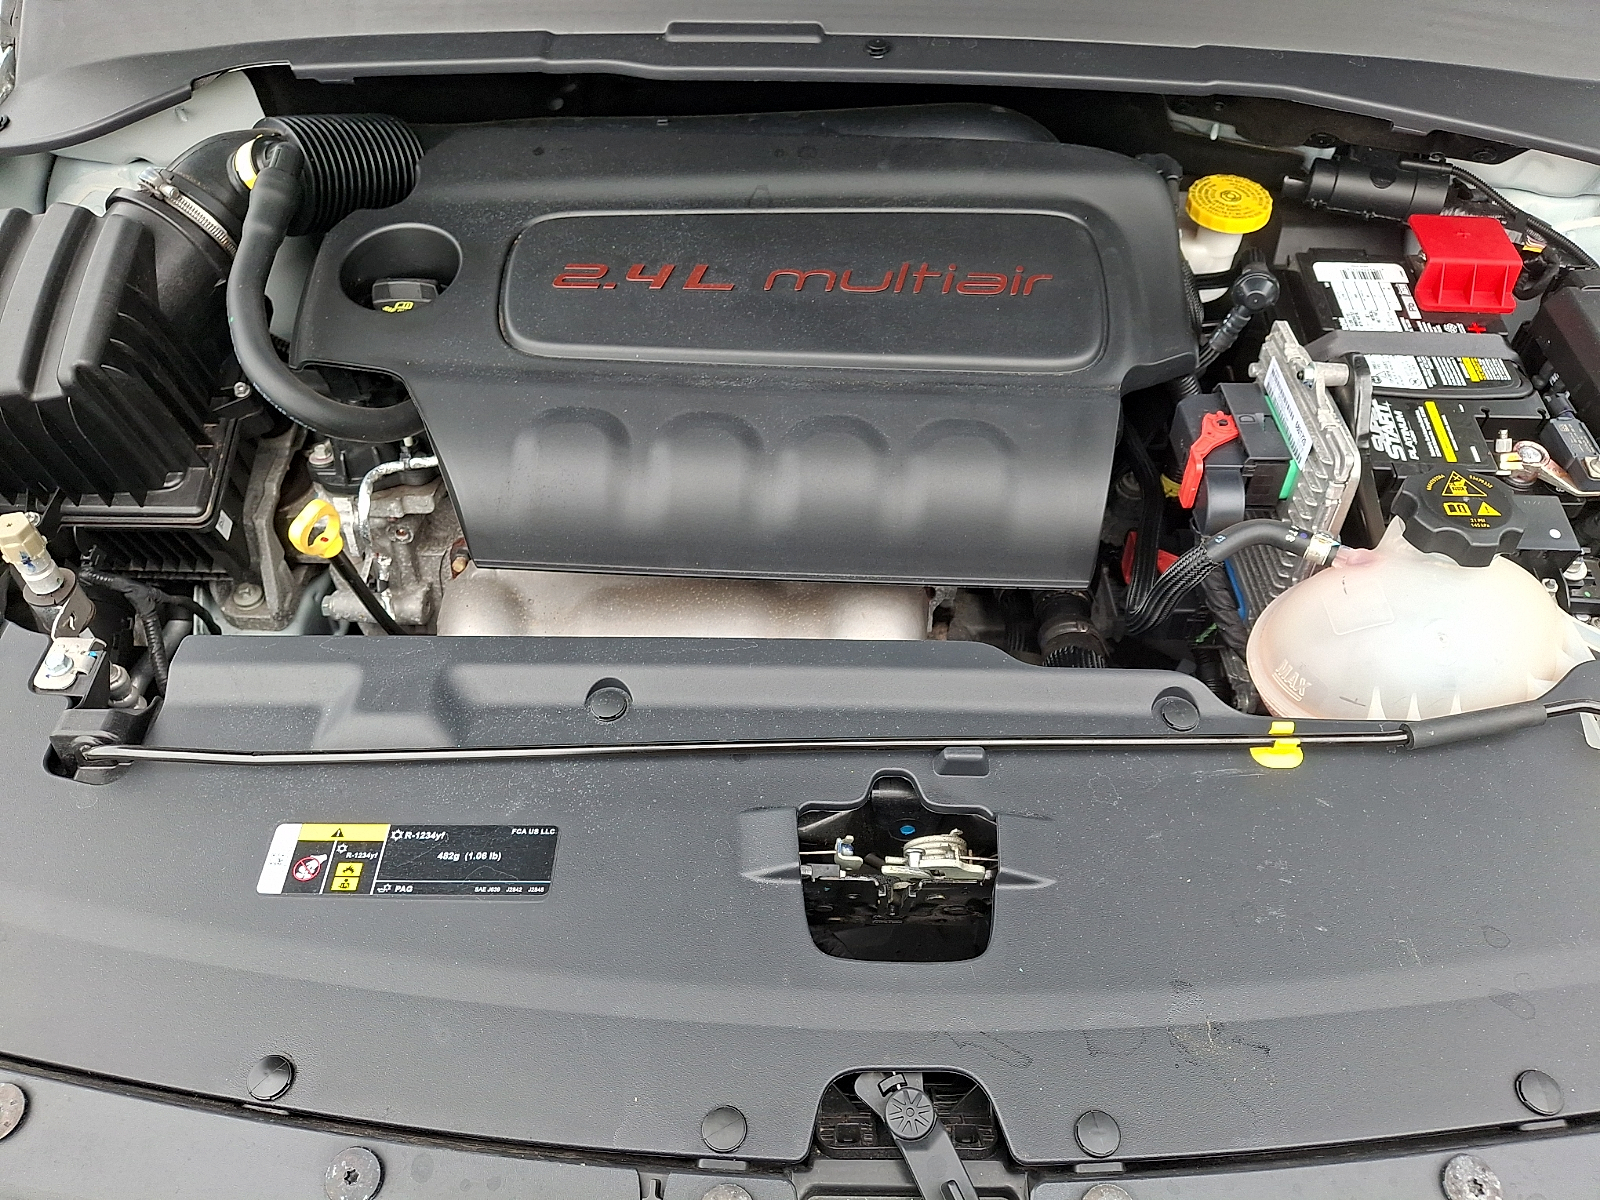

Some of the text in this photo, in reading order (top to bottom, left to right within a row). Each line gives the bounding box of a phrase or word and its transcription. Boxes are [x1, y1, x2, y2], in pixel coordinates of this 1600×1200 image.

[552, 262, 1054, 296] 2.4L multiair
[1378, 403, 1408, 461] START
[1393, 410, 1420, 460] PLATINUM
[1275, 658, 1312, 697] MAX
[404, 831, 447, 842] R-1234yf
[345, 851, 379, 860] R-1234yf
[437, 852, 502, 862] 482g (1.06 lb)
[394, 885, 413, 893] PAG
